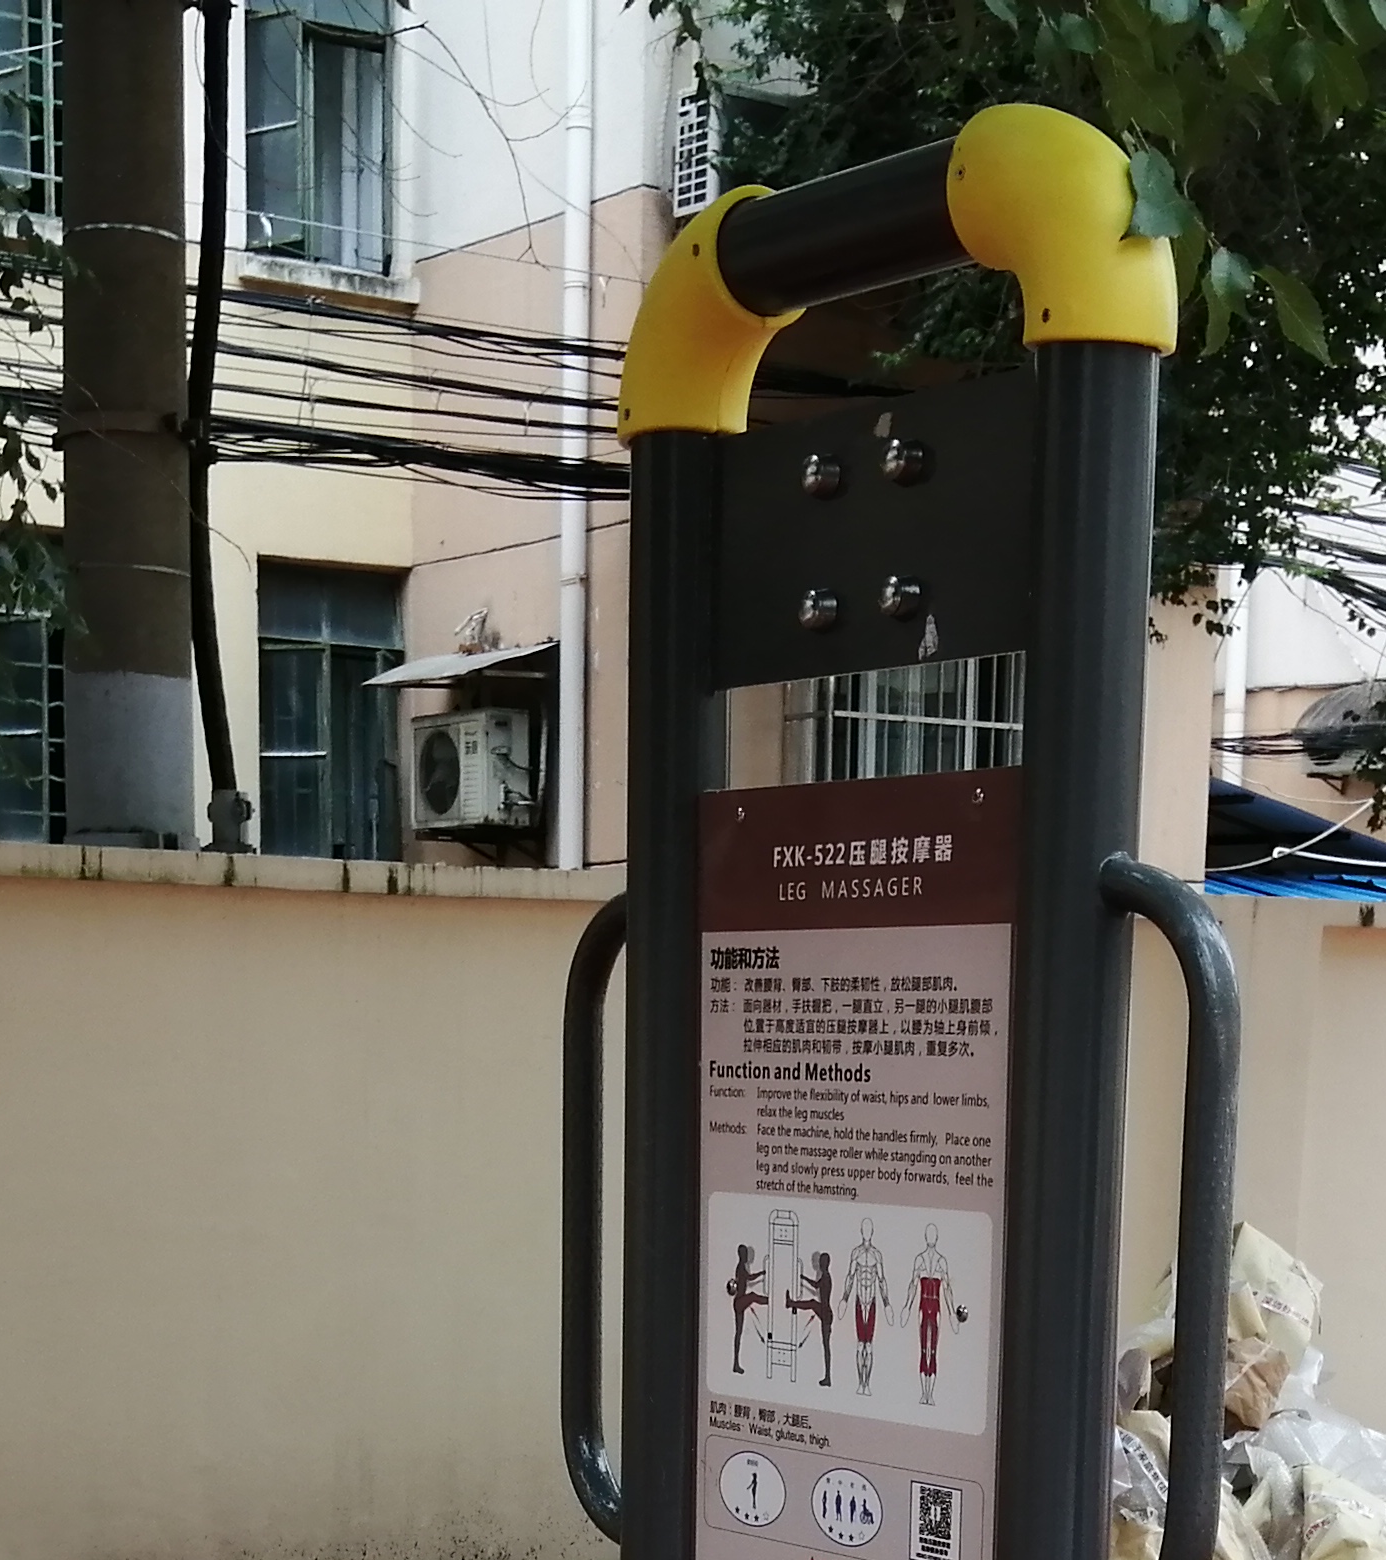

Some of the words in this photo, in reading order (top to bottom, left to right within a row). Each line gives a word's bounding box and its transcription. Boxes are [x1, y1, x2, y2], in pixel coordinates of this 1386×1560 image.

[773, 834, 952, 868] FXK-522压腿按摩器
[778, 881, 806, 901] LEG
[821, 875, 922, 898] MASSAGER
[709, 945, 780, 970] 功能和方法
[709, 1059, 770, 1079] Function
[773, 1061, 800, 1080] and
[804, 1061, 871, 1083] Methods
[708, 1084, 744, 1098] Function:
[756, 1086, 792, 1100] Improve
[792, 1087, 808, 1101] the
[809, 1087, 849, 1105] flexibility
[849, 1088, 860, 1102] of
[861, 1092, 887, 1105] waist,
[889, 1090, 909, 1107] hips
[910, 1091, 929, 1105] and
[932, 1091, 960, 1106] lower
[960, 1093, 989, 1108] limbs,
[756, 1104, 777, 1117] relax
[778, 1105, 793, 1118] the
[794, 1105, 808, 1122] leg
[809, 1107, 845, 1121] muscles
[708, 1120, 747, 1135] Methods:
[756, 1122, 775, 1136] Face
[776, 1124, 791, 1137] the
[792, 1125, 831, 1140] machine,
[832, 1126, 853, 1140] hold
[855, 1127, 870, 1141] the
[871, 1128, 908, 1143] handles
[908, 1129, 938, 1148] firmly,
[944, 1131, 970, 1146] Place
[971, 1135, 991, 1147] one
[755, 1140, 769, 1157] leg
[783, 1142, 799, 1156] the
[799, 1146, 838, 1161] massage
[839, 1146, 863, 1159] roller
[864, 1147, 889, 1161] while
[889, 1149, 937, 1167] stangding
[938, 1154, 952, 1165] on
[952, 1153, 992, 1167] another
[755, 1158, 770, 1175] leg
[771, 1160, 789, 1173] and
[790, 1161, 819, 1179] slowly
[820, 1166, 845, 1178] press
[846, 1167, 875, 1181] upper
[876, 1166, 902, 1184] body
[903, 1167, 949, 1185] forwards,
[954, 1171, 974, 1186] feel
[976, 1173, 994, 1187] the
[755, 1178, 784, 1191] stretch
[796, 1180, 811, 1194] the
[812, 1181, 859, 1201] hamstring.
